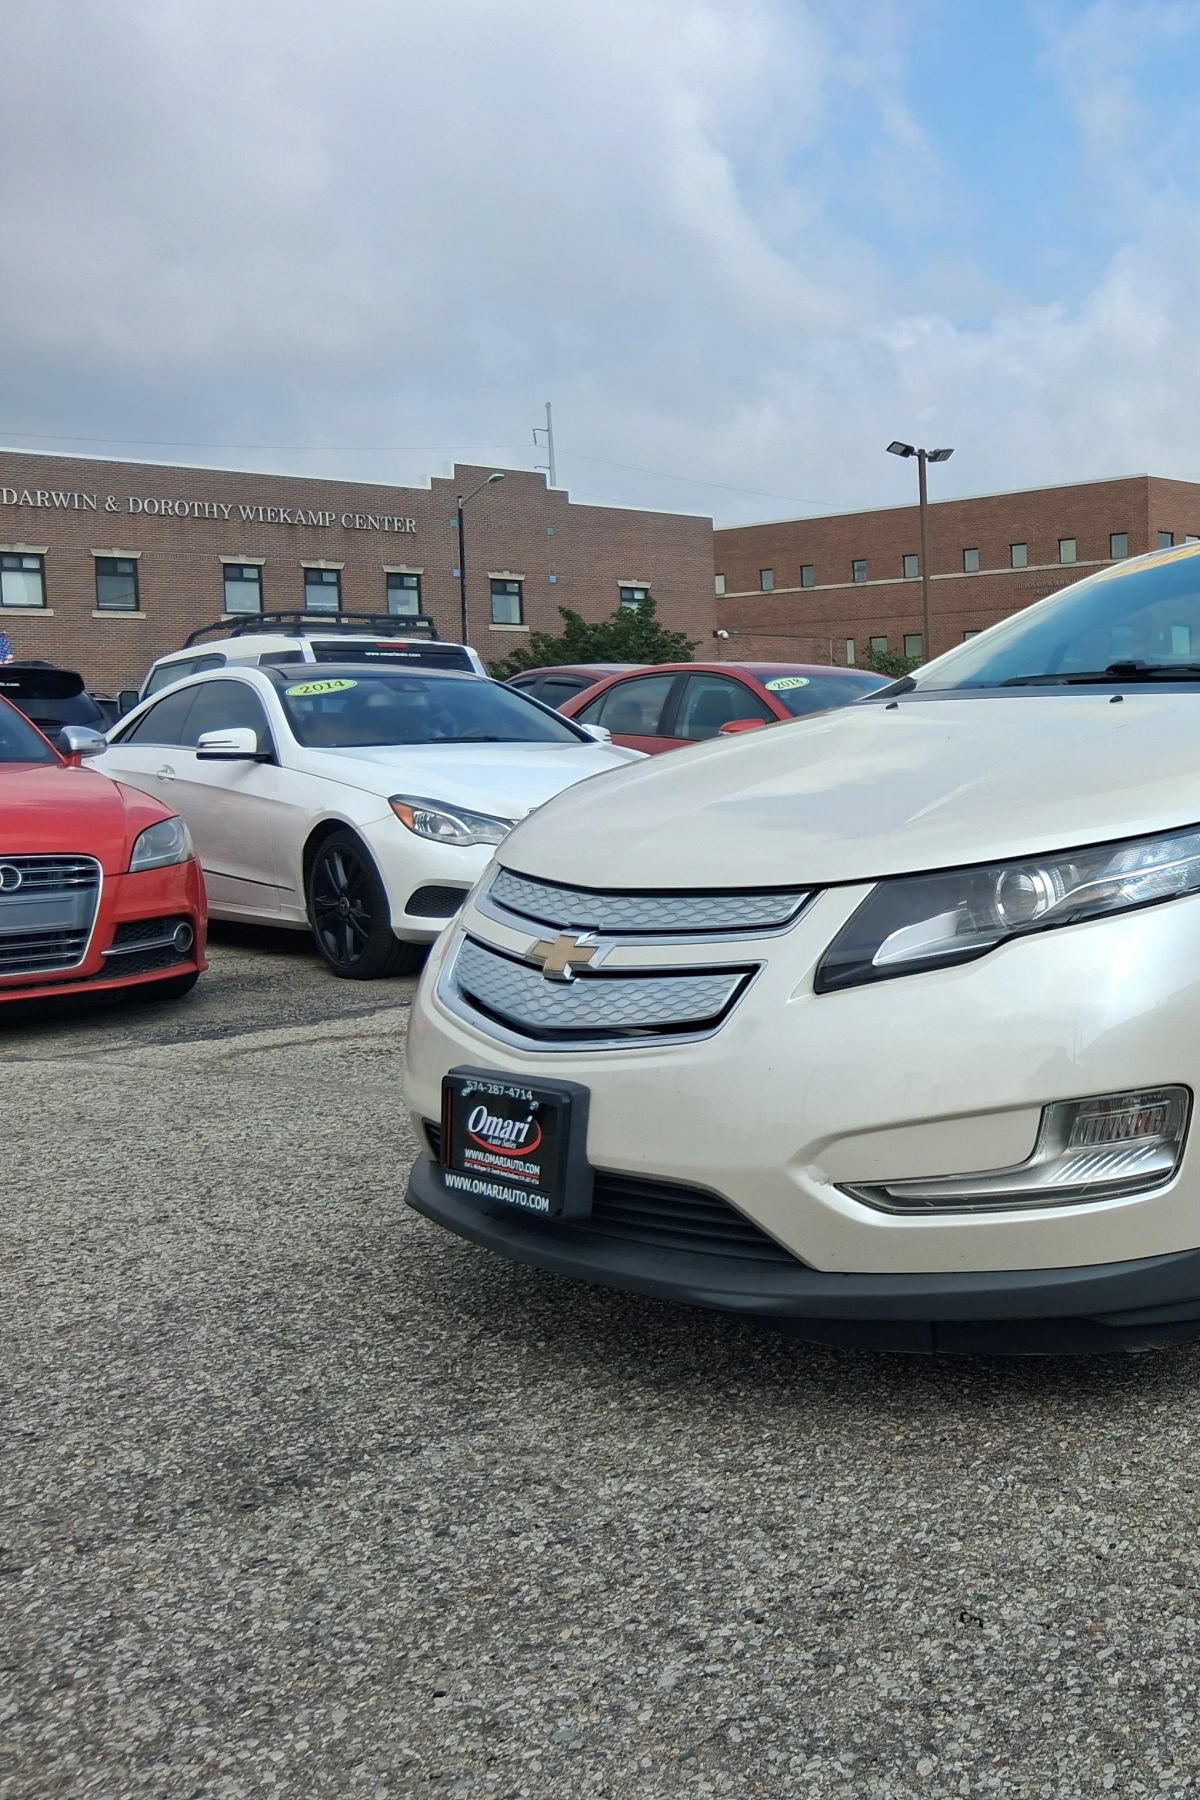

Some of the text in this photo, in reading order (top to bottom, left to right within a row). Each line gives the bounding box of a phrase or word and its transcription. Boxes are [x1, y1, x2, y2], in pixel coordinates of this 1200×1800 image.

[1, 487, 418, 534] DARWIN & DOROTHY WIEKAMP CENTER
[299, 681, 345, 693] 2014
[467, 1080, 533, 1100] 574-287-4714
[468, 1105, 533, 1143] Omari
[464, 1148, 541, 1175] WWW.OMARIAUTO.COM
[445, 1173, 550, 1212] WWW.OMARIAUTO.COM
